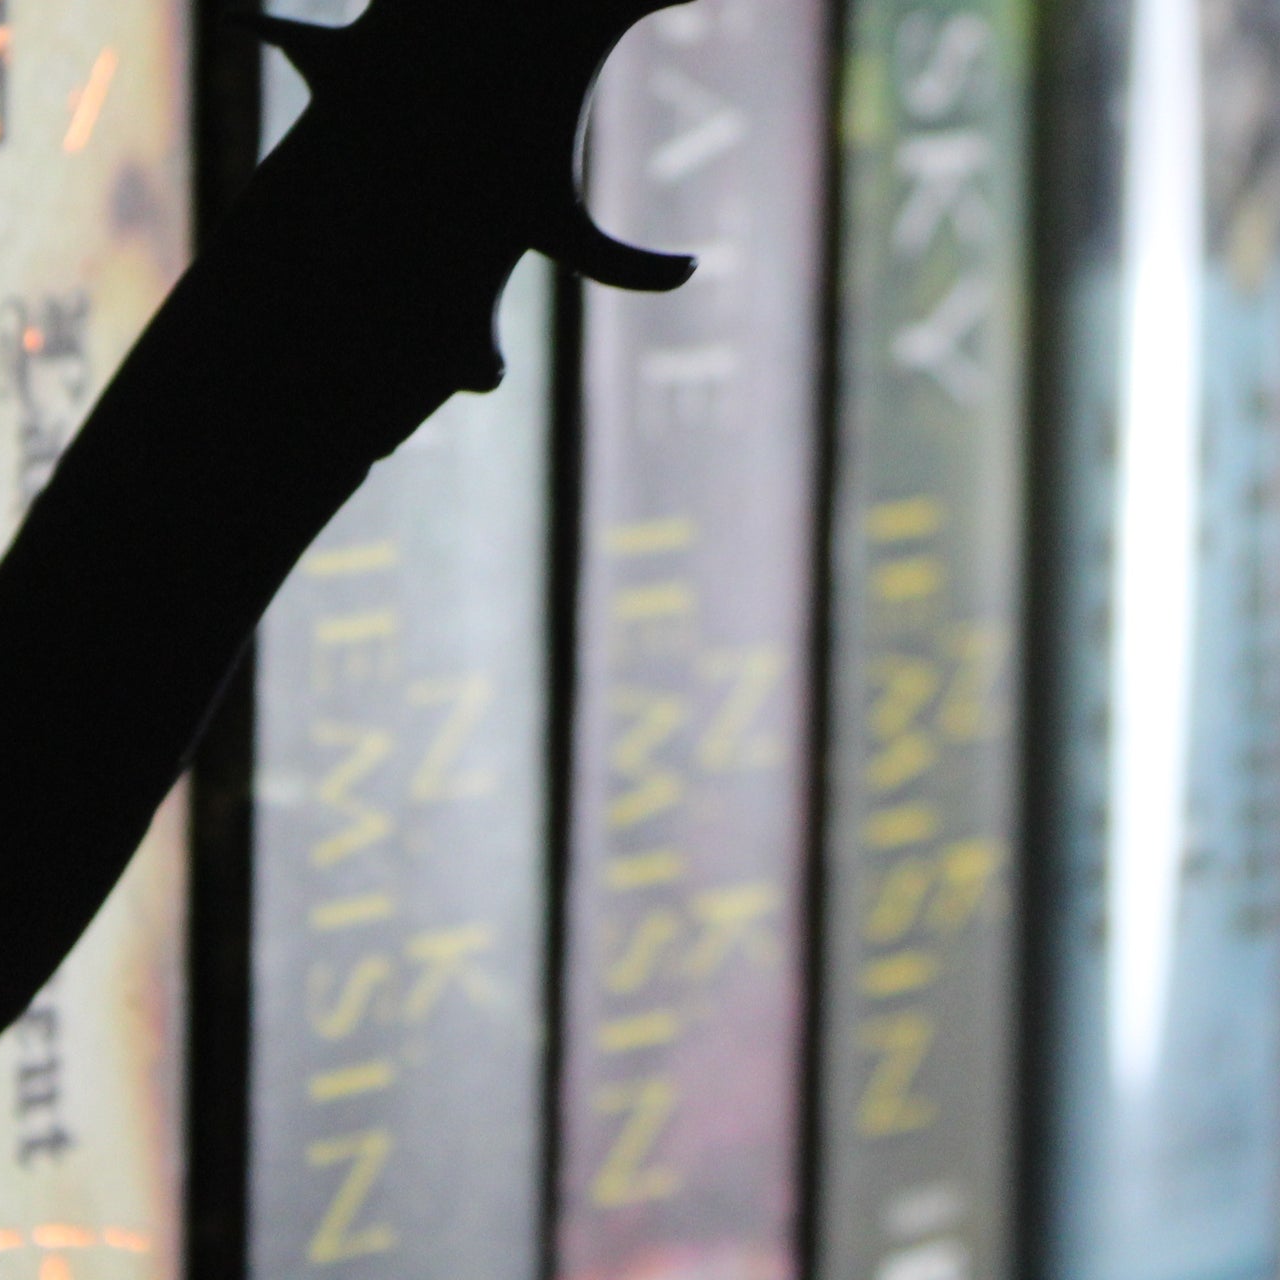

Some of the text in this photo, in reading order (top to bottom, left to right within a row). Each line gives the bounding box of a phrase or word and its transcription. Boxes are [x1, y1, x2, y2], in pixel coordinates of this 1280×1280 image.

[890, 8, 998, 410] SKY
[302, 538, 402, 1268] JEMISIN
[584, 518, 700, 1208] JEMISIN
